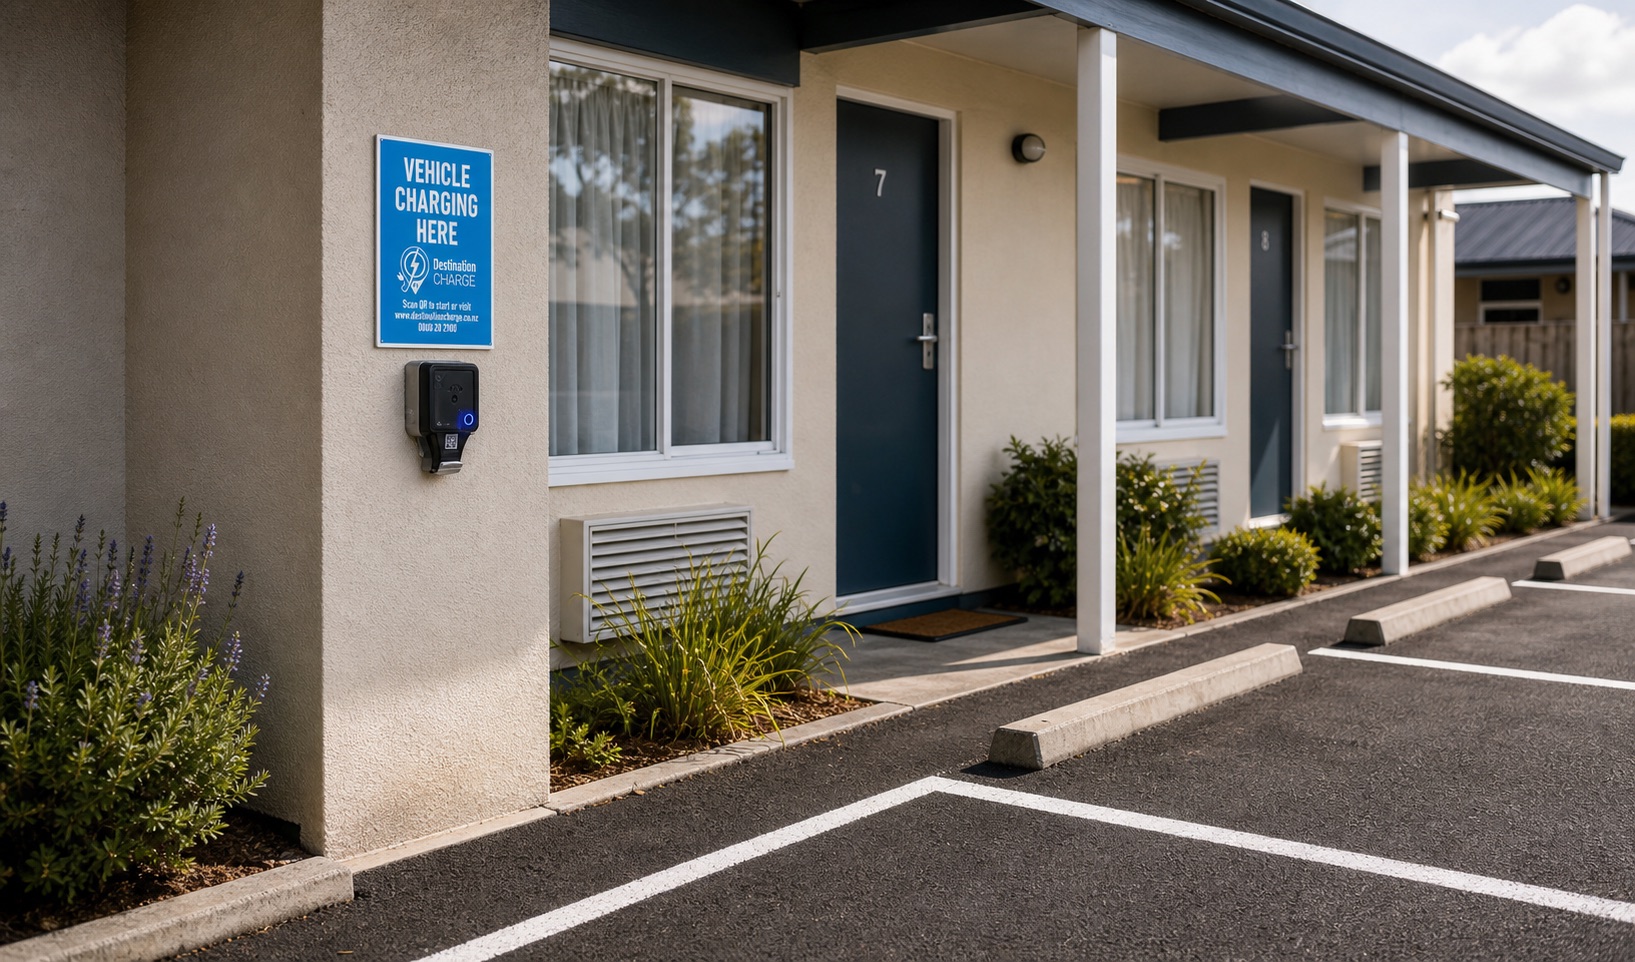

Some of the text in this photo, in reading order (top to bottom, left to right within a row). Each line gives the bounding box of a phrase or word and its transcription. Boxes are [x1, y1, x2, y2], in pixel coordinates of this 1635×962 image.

[403, 157, 471, 188] VEHICLE
[875, 168, 887, 197] 7
[395, 186, 478, 218] CHARGING
[416, 218, 459, 246] HERE
[1261, 230, 1270, 251] 8
[433, 258, 477, 273] Destination
[433, 272, 476, 288] CHARGE
[402, 299, 418, 309] Scan
[419, 299, 428, 311] QR
[394, 310, 479, 323] www.desttncharge.co.nz
